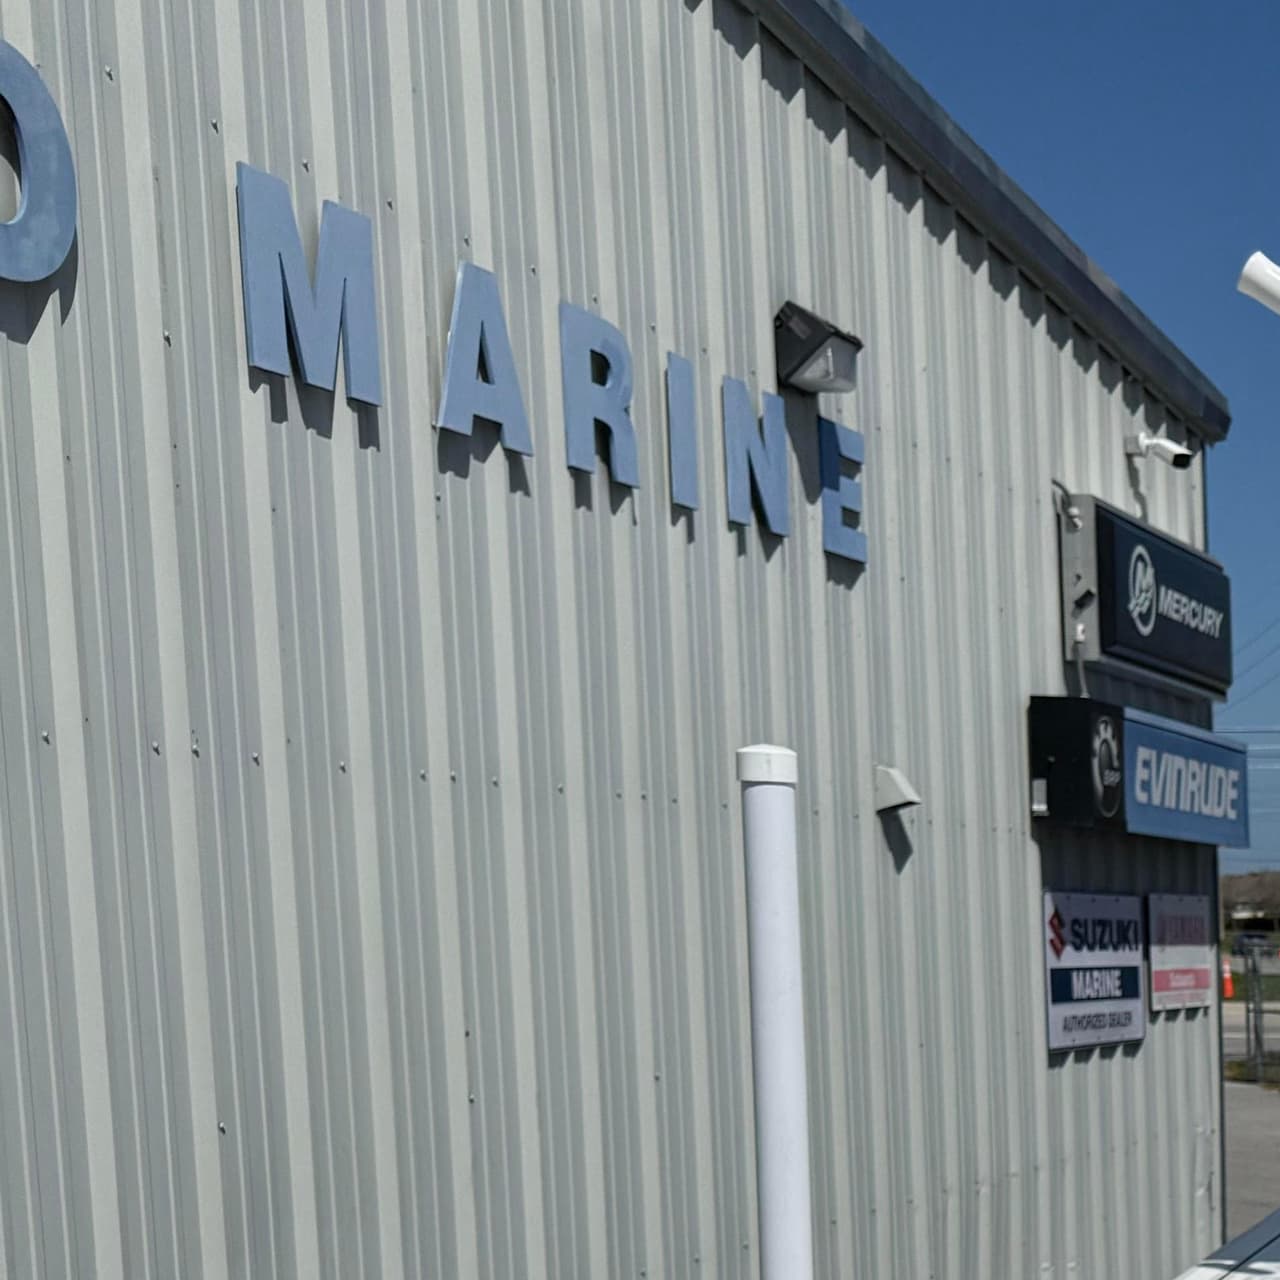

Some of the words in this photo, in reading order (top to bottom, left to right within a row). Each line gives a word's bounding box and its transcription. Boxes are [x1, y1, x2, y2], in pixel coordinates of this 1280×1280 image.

[236, 161, 867, 565] MARINE
[1158, 585, 1224, 638] MERCURY
[1134, 745, 1240, 820] EVINRUDE
[1070, 918, 1139, 952] SUZUKI
[1072, 968, 1122, 1000] MARINE
